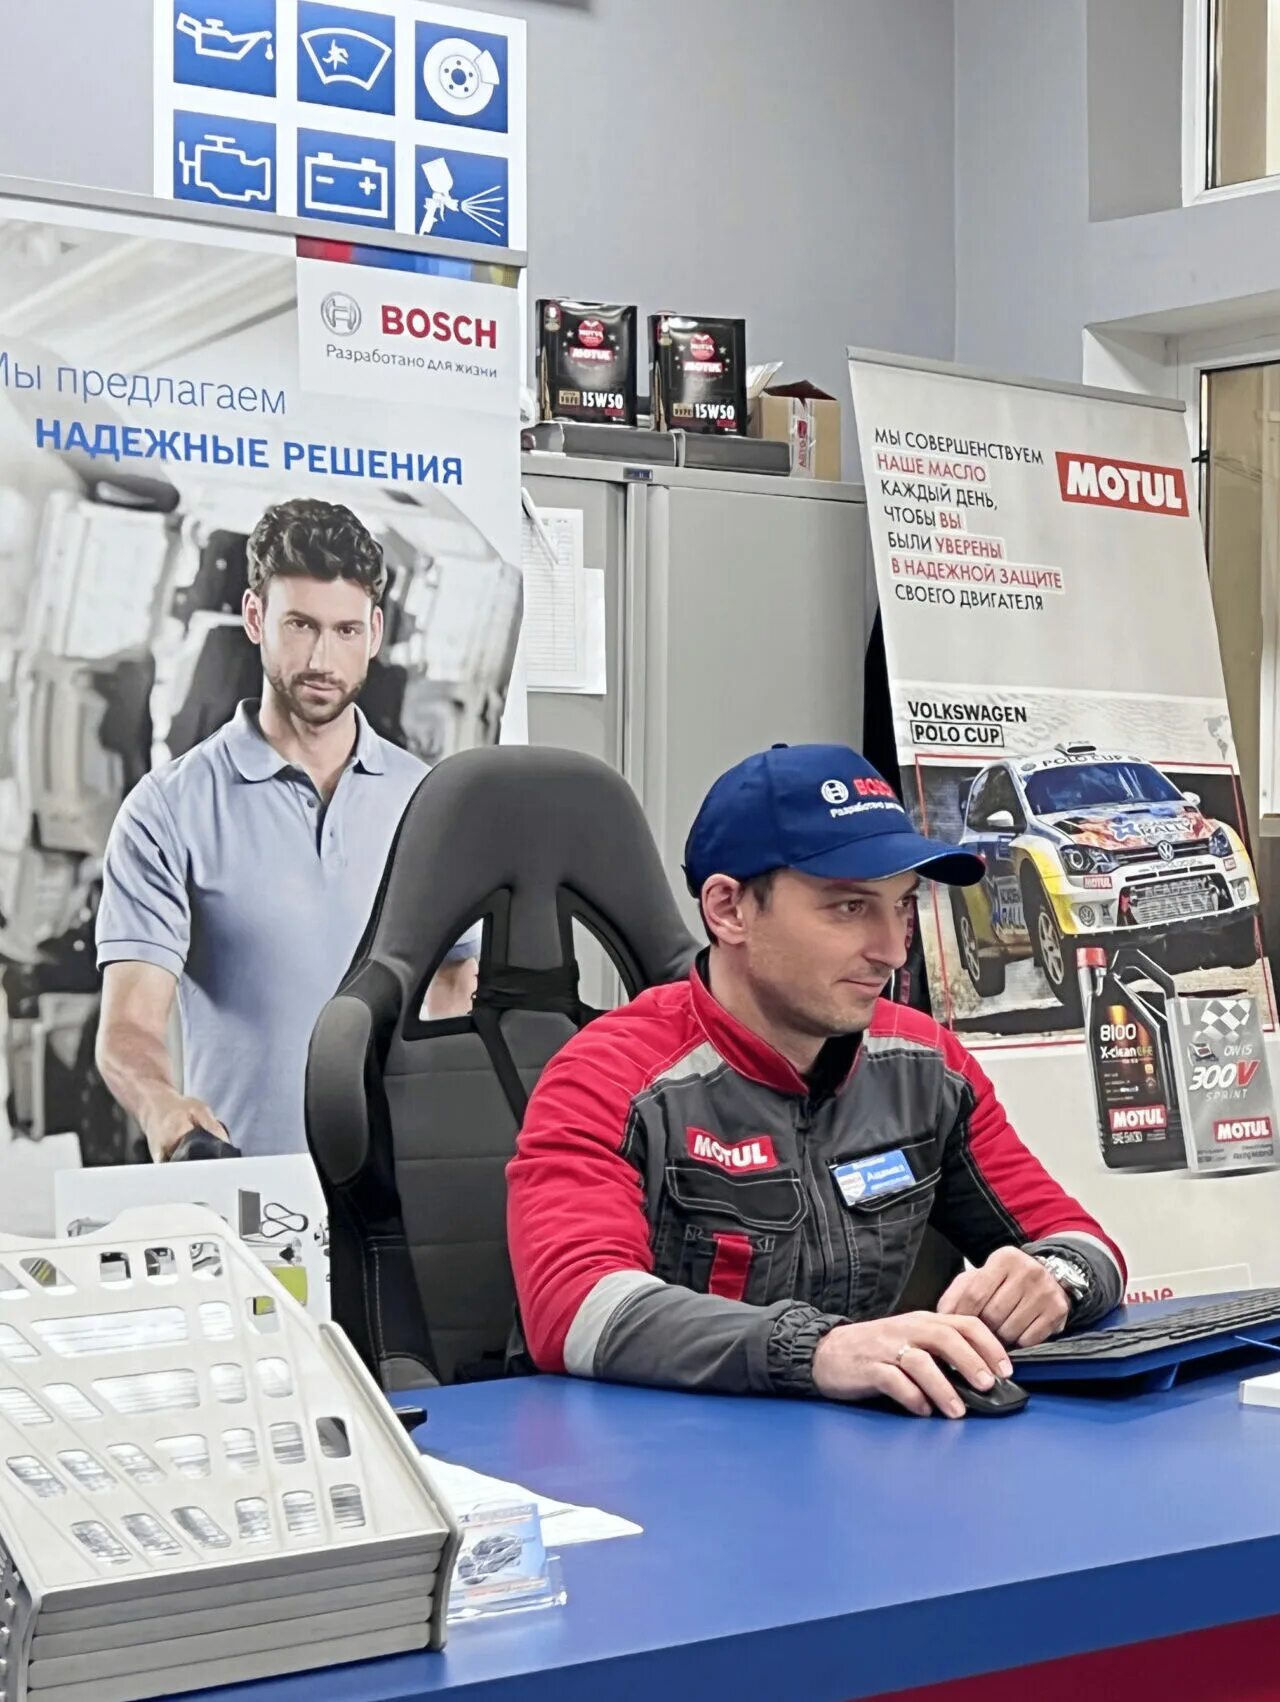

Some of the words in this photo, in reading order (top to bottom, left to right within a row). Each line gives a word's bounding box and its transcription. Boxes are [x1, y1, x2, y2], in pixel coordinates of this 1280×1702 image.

[381, 304, 498, 349] BOSCH
[326, 344, 425, 369] Разработано
[427, 357, 453, 373] для
[455, 363, 498, 378] жизни
[57, 365, 286, 415] предлагаем
[582, 391, 624, 410] 15W50
[695, 403, 735, 420] 15W50
[36, 418, 269, 468] НАДЕЖНЫЕ
[283, 441, 464, 485] РЕШЕНИЯ
[875, 427, 901, 445] МЫ
[904, 431, 1044, 465] СОВЕРШЕНСТВУЕМ
[876, 454, 924, 475] НАШЕ
[928, 459, 986, 482] МАСЛО
[880, 479, 951, 503] КАЖДЫЙ
[956, 488, 998, 511] ДЕНЬ,
[1066, 460, 1182, 510] MOTUL
[884, 505, 936, 527] ЧТОБЫ
[939, 512, 962, 529] ВЫ
[888, 531, 933, 553] БЫЛИ
[935, 537, 1002, 559] УВЕРЕНЫ
[891, 558, 901, 574] В
[904, 560, 995, 583] НАДЕЖНОЙ
[999, 567, 1063, 589] ЗАЩИТЕ
[895, 584, 955, 605] СВОЕГО
[960, 589, 1044, 612] ДВИГАТЕЛЯ
[907, 700, 1027, 723] VOLKSWAGEN
[914, 723, 960, 742] POLO
[963, 726, 1000, 744] CUP
[1042, 753, 1088, 768] POLO
[1091, 753, 1123, 763] CUP
[1100, 1023, 1137, 1042] 8100
[1100, 1045, 1137, 1059] X-clean
[1189, 1059, 1261, 1091] 300V
[1204, 1088, 1249, 1102] SPRINT
[1112, 1107, 1165, 1129] MOTUL
[1216, 1120, 1270, 1141] MOTUL
[693, 1134, 769, 1168] MOTUL
